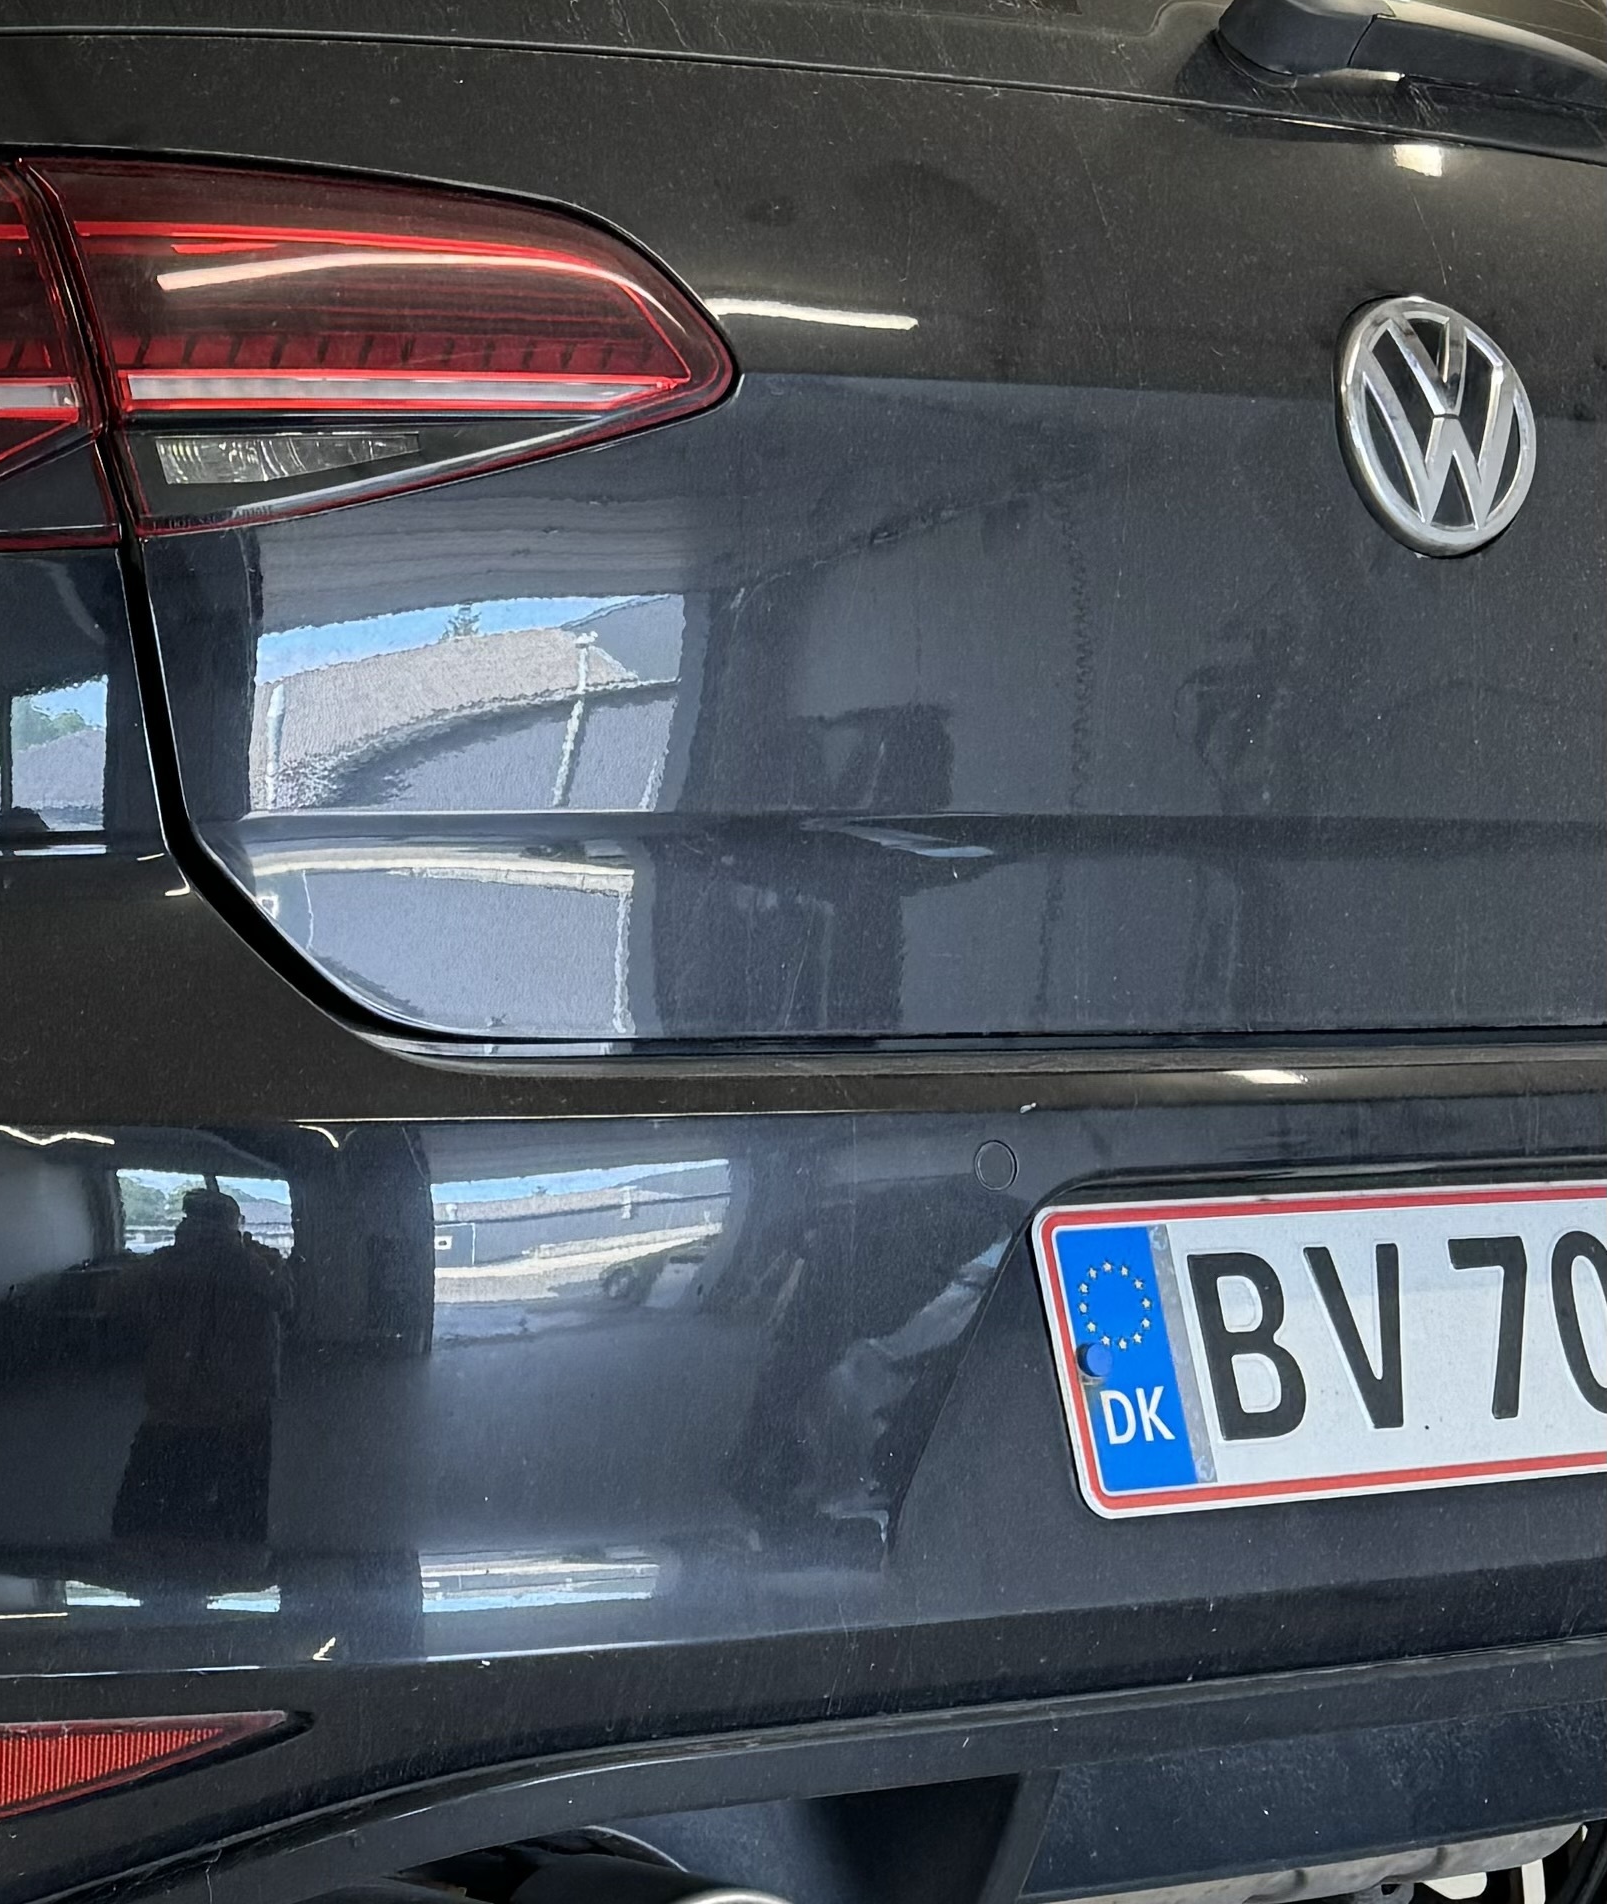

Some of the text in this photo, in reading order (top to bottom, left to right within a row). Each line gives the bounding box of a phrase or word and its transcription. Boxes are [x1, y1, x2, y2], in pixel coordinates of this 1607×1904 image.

[1187, 1230, 1607, 1441] BV 70
[1100, 1386, 1175, 1445] DK
